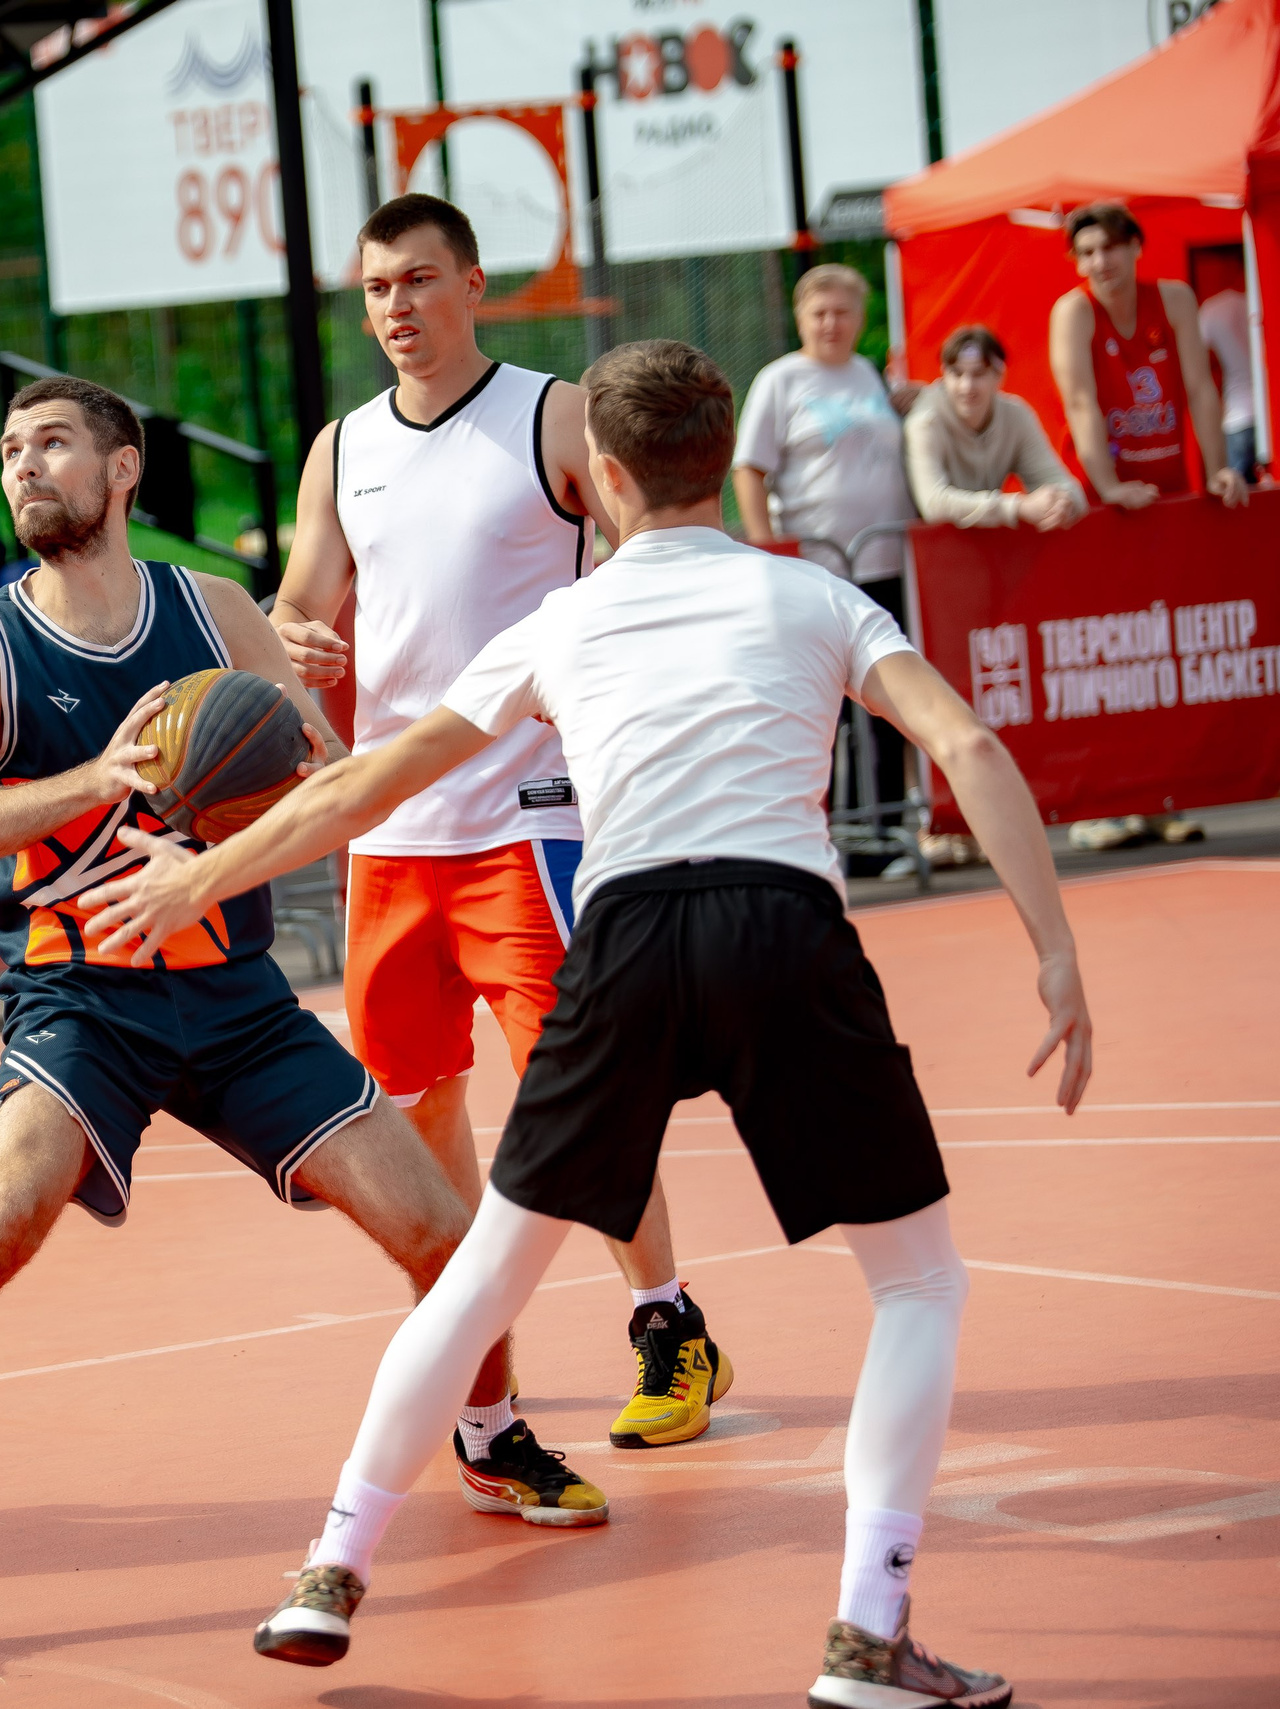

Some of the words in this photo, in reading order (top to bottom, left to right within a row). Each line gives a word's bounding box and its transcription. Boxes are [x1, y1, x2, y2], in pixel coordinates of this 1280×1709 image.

[170, 101, 270, 156] ТВЕР
[363, 485, 387, 495] SPORT
[1037, 600, 1170, 669] ТВЕРСКОЙ
[1174, 599, 1257, 656] ЦЕНТР
[1042, 657, 1178, 721] УЛИЧНОГО
[646, 1320, 669, 1329] PEAK
